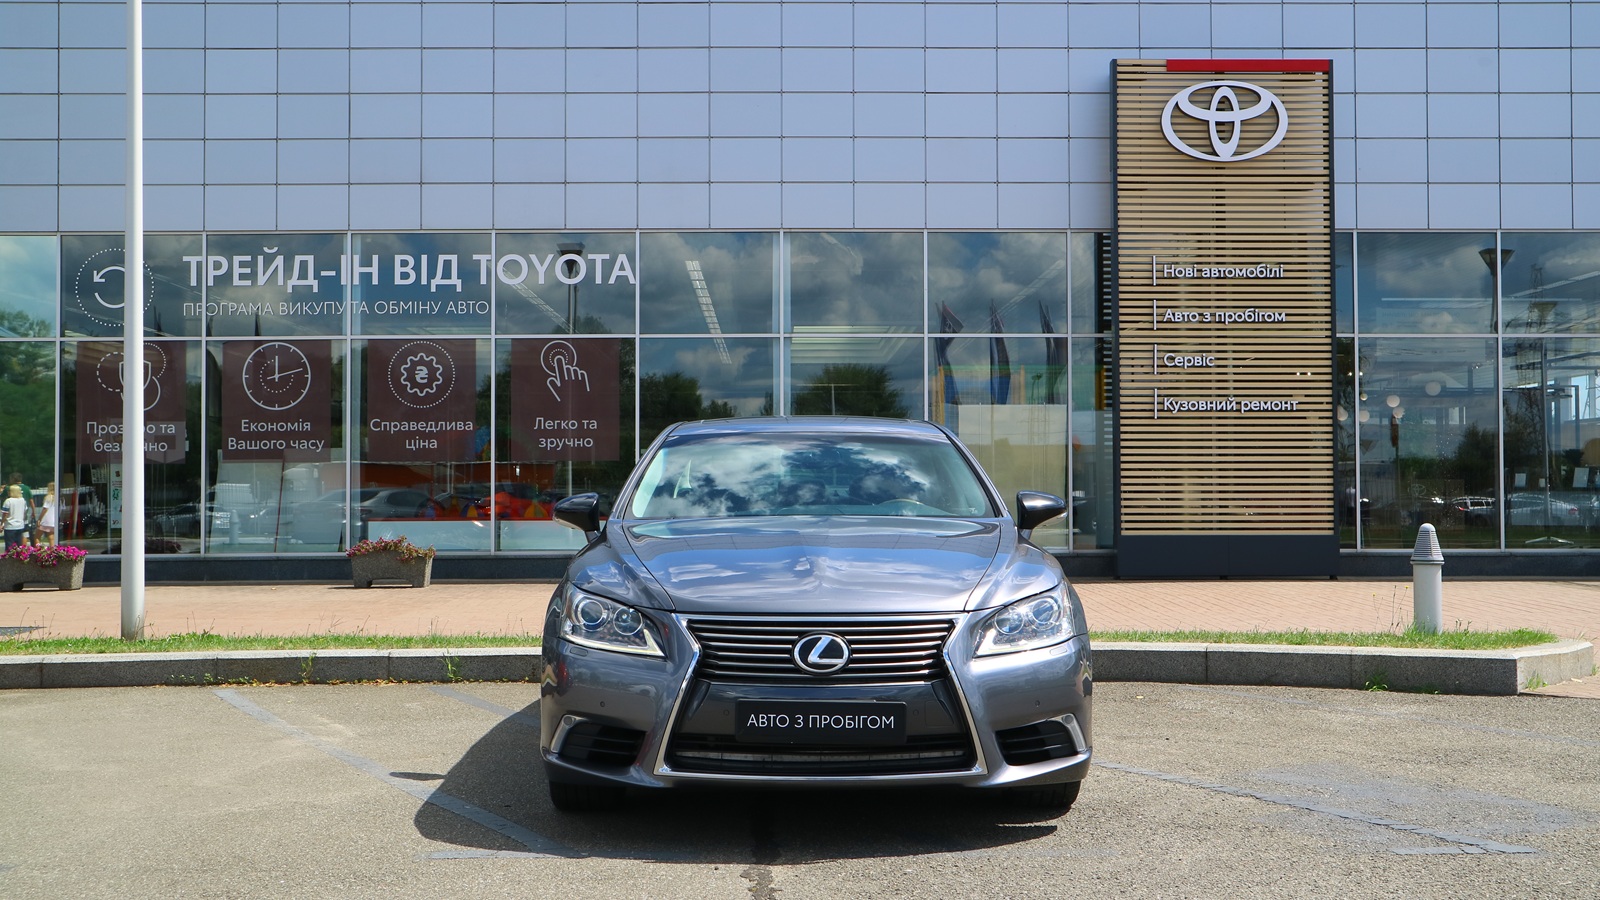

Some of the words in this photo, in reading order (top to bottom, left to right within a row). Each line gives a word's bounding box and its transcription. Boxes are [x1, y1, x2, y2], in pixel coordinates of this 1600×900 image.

[183, 247, 378, 292] ТРЕЙД-ІН
[394, 254, 462, 292] ВІД
[473, 253, 636, 285] TOYOTA
[1163, 264, 1197, 278] Нові
[1202, 263, 1284, 278] автомобілі
[183, 302, 273, 316] ПРОГРАМА
[279, 301, 347, 315] ВИКУПУ
[351, 301, 369, 314] ТА
[374, 300, 441, 314] ОБМІНУ
[446, 300, 490, 314] АВТО
[1163, 309, 1199, 323] Авто
[1202, 312, 1211, 323] з
[1215, 308, 1286, 325] пробігом
[1163, 353, 1215, 369] Сервіс
[1163, 397, 1237, 414] Кузовний
[1241, 399, 1299, 413] ремонт
[86, 422, 156, 437] Прозо
[160, 424, 176, 434] та
[241, 419, 311, 432] Економія
[370, 419, 473, 434] Справедлива
[534, 418, 578, 431] Легко
[581, 420, 598, 431] та
[228, 438, 287, 451] Вашого
[290, 440, 325, 452] часу
[405, 437, 438, 450] ціна
[538, 438, 594, 450] зручно
[747, 714, 790, 728] АВТО
[809, 715, 894, 729] ПРОБІГОМ
